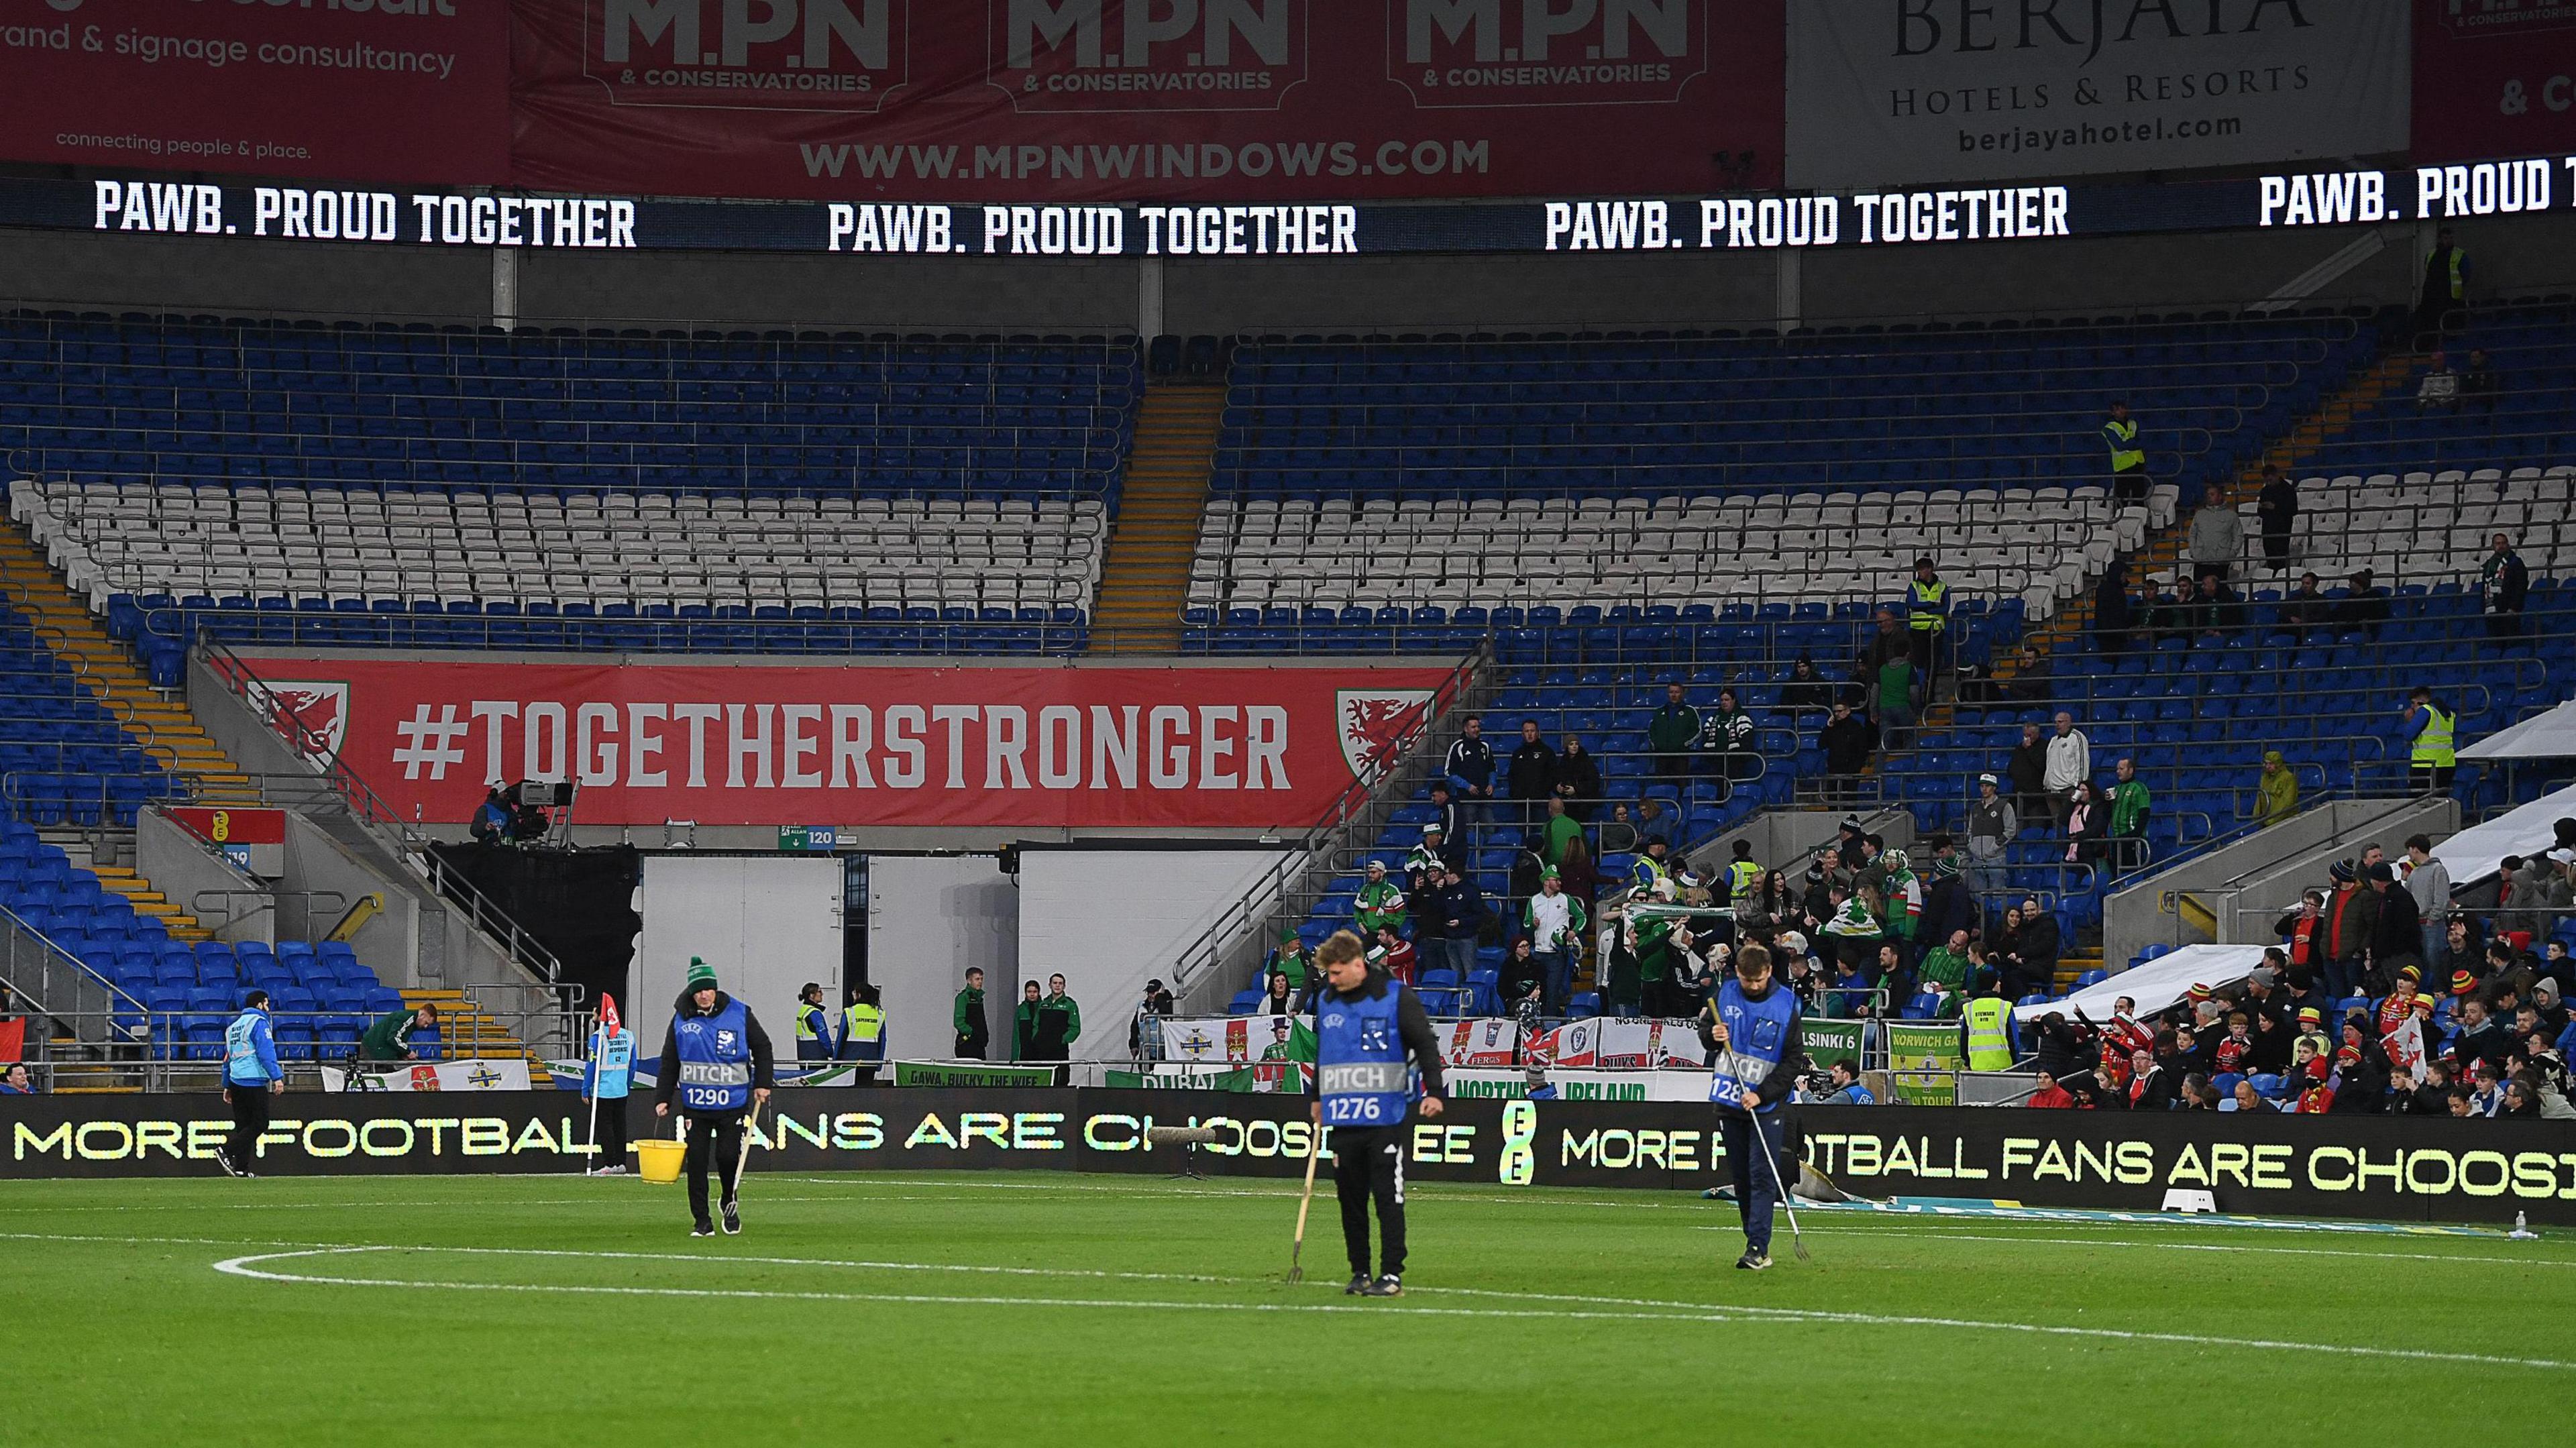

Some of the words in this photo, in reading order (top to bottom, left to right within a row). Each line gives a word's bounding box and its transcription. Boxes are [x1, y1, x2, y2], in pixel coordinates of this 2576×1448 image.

[604, 0, 888, 68] M.P.N
[1008, 0, 1288, 68] M.P.N
[1407, 0, 1686, 63] M.P.N
[82, 25, 103, 52] &
[115, 28, 247, 67] signage
[258, 42, 455, 79] consultancy
[621, 69, 635, 84] &
[645, 70, 871, 94] CONSERVATORIES
[1024, 74, 1038, 91] &
[1047, 72, 1271, 91] CONSERVATORIES
[1424, 69, 1438, 87] &
[1447, 64, 1670, 86] CONSERVATORIES
[1890, 84, 2049, 117] HOTELS
[2074, 77, 2102, 105] &
[2126, 65, 2308, 102] RESORTS
[2500, 78, 2528, 115] &
[2542, 74, 2576, 113] C
[54, 130, 162, 156] connecting
[166, 138, 232, 158] people
[237, 140, 251, 156] &
[255, 142, 313, 161] place.
[1959, 116, 2241, 154] berjayahotel.com
[800, 140, 1488, 179] WWW.MPNWINDOWS.COM
[2260, 172, 2398, 225] PAWB.
[2417, 160, 2549, 218] PROUD
[95, 181, 235, 233] PAWB.
[255, 188, 395, 240] PROUD
[413, 195, 636, 247] TOGETHER
[828, 205, 965, 252] PAWB.
[983, 207, 1122, 254] PROUD
[1140, 206, 1357, 254] TOGETHER
[1546, 201, 1682, 249] PAWB.
[1701, 197, 1837, 247] PROUD
[1854, 187, 2069, 242] TOGETHER
[393, 700, 1291, 791] #TOGETHERSTRONGER
[808, 832, 832, 844] 120
[1802, 1032, 1843, 1049] LSINKI
[1847, 1035, 1855, 1049] 6
[1893, 1034, 1941, 1048] NORWICH
[682, 1064, 734, 1082] PITCH
[989, 1074, 1008, 1087] THE
[1011, 1075, 1037, 1087] WIFE
[1324, 1068, 1386, 1089] PITCH
[686, 1087, 730, 1106] 1290
[1456, 1080, 1534, 1099] NORTH
[1566, 1081, 1645, 1101] IRELAND
[1711, 1078, 1751, 1103] 128
[1924, 1096, 1951, 1105] TOUR
[1328, 1097, 1380, 1120] 1276
[15, 1121, 235, 1161] MORE
[256, 1118, 602, 1157] FOOTBAL
[676, 1112, 883, 1150] ANS
[905, 1113, 1064, 1149] ARE
[1085, 1114, 1334, 1158] CHOOSI
[1413, 1125, 1476, 1164] EE
[1562, 1129, 1700, 1170] MORE
[1712, 1131, 1988, 1180] FTBALL
[2002, 1138, 2153, 1183] FANS
[2166, 1143, 2292, 1189] ARE
